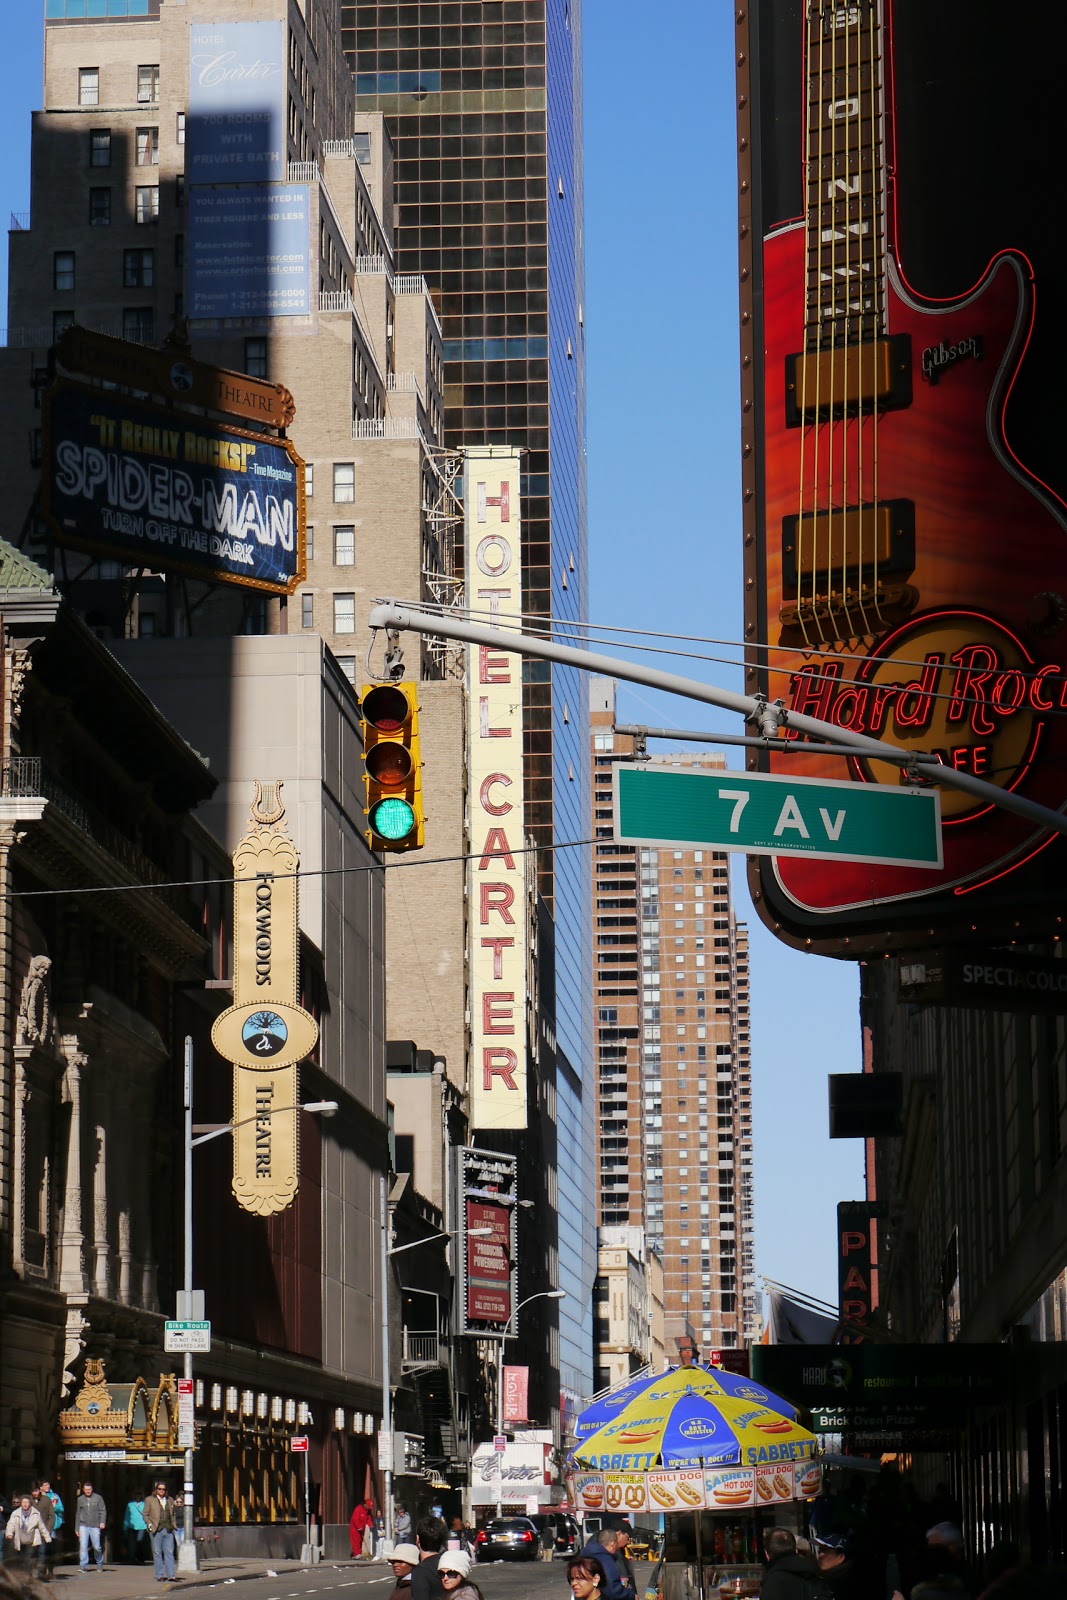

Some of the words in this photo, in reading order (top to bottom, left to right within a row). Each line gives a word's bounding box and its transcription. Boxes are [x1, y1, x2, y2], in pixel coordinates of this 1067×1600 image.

[193, 35, 224, 44] HOTEL
[191, 50, 280, 88] Carter
[203, 115, 224, 125] 700
[228, 113, 271, 124] ROOMS
[221, 132, 252, 144] WITH
[193, 153, 244, 164] PRIVATE
[247, 152, 280, 162] BATH
[196, 198, 214, 206] YOU
[216, 197, 251, 206] ALWAYS
[254, 196, 291, 204] WANTED
[195, 215, 222, 224] TIMES
[223, 214, 258, 223] SQUARE
[260, 213, 280, 222] AND
[922, 336, 979, 374] Gibson
[217, 384, 275, 413] THEATRE
[56, 440, 294, 552] SPIDER-MAN
[101, 508, 144, 538] TURN
[145, 521, 178, 545] OFF
[178, 526, 208, 553] THE
[210, 534, 254, 566] DARK
[476, 480, 513, 740] HOTEL
[784, 652, 940, 742] Hard
[948, 644, 1067, 736] Roc
[718, 789, 750, 833] 7
[256, 870, 274, 986] FOXWOODS
[478, 772, 519, 1091] CARTER
[255, 1080, 275, 1180] THEATRE
[603, 1416, 665, 1437] SABRETT
[732, 1410, 771, 1428] SABRETT
[820, 1416, 849, 1426] Brick
[853, 1416, 883, 1426] Oven
[886, 1414, 916, 1424] Pizza
[668, 1458, 688, 1466] WE'RE
[708, 1456, 723, 1464] ROLL
[748, 1440, 816, 1464] SABRETT
[605, 1474, 644, 1484] PRETZELS
[649, 1474, 676, 1482] CHILI
[680, 1472, 702, 1481] DOG
[756, 1468, 774, 1476] CHILI
[776, 1466, 792, 1474] DOG
[576, 1476, 602, 1493] SABRETT
[706, 1470, 753, 1492] SABRETT
[724, 1482, 738, 1490] HOT
